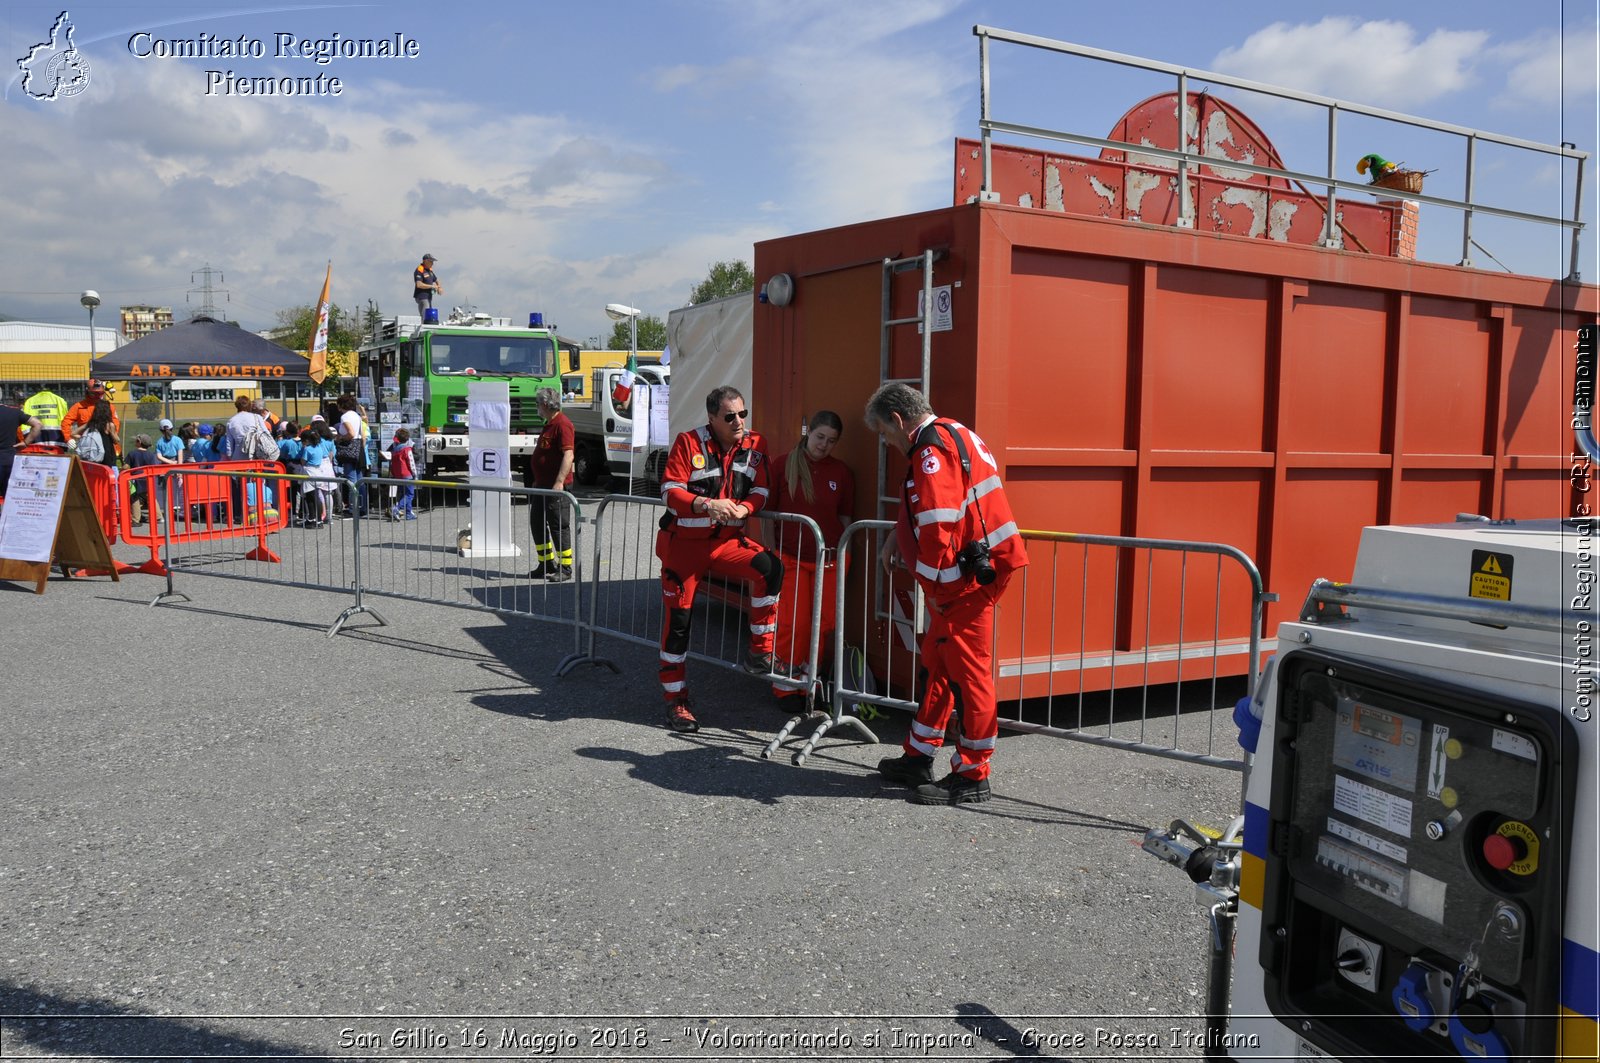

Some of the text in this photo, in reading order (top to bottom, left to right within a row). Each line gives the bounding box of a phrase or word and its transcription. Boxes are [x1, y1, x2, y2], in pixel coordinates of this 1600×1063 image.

[129, 363, 285, 378] A.I.B. GIVOLETTO
[615, 425, 633, 433] COMUN
[482, 452, 496, 472] E
[1474, 576, 1508, 587] CAUTION:
[1435, 726, 1448, 735] UP
[1500, 823, 1537, 843] ERGENCY
[1510, 863, 1532, 873] STOP
